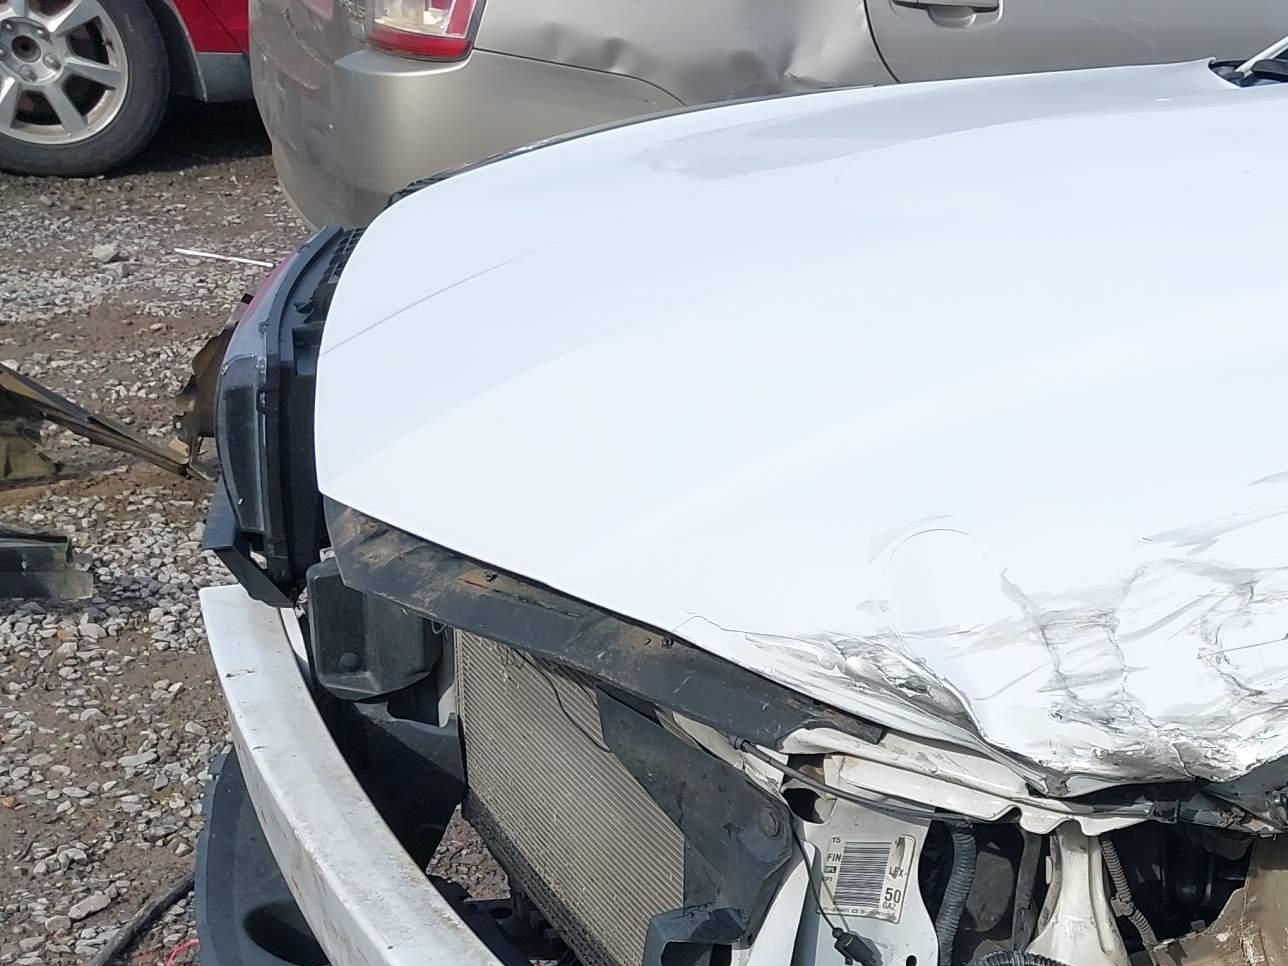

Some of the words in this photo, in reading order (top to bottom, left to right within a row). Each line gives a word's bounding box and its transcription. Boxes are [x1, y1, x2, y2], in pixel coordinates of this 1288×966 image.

[827, 853, 842, 862] FIN
[884, 887, 902, 904] 50
[882, 901, 897, 911] GAZ
